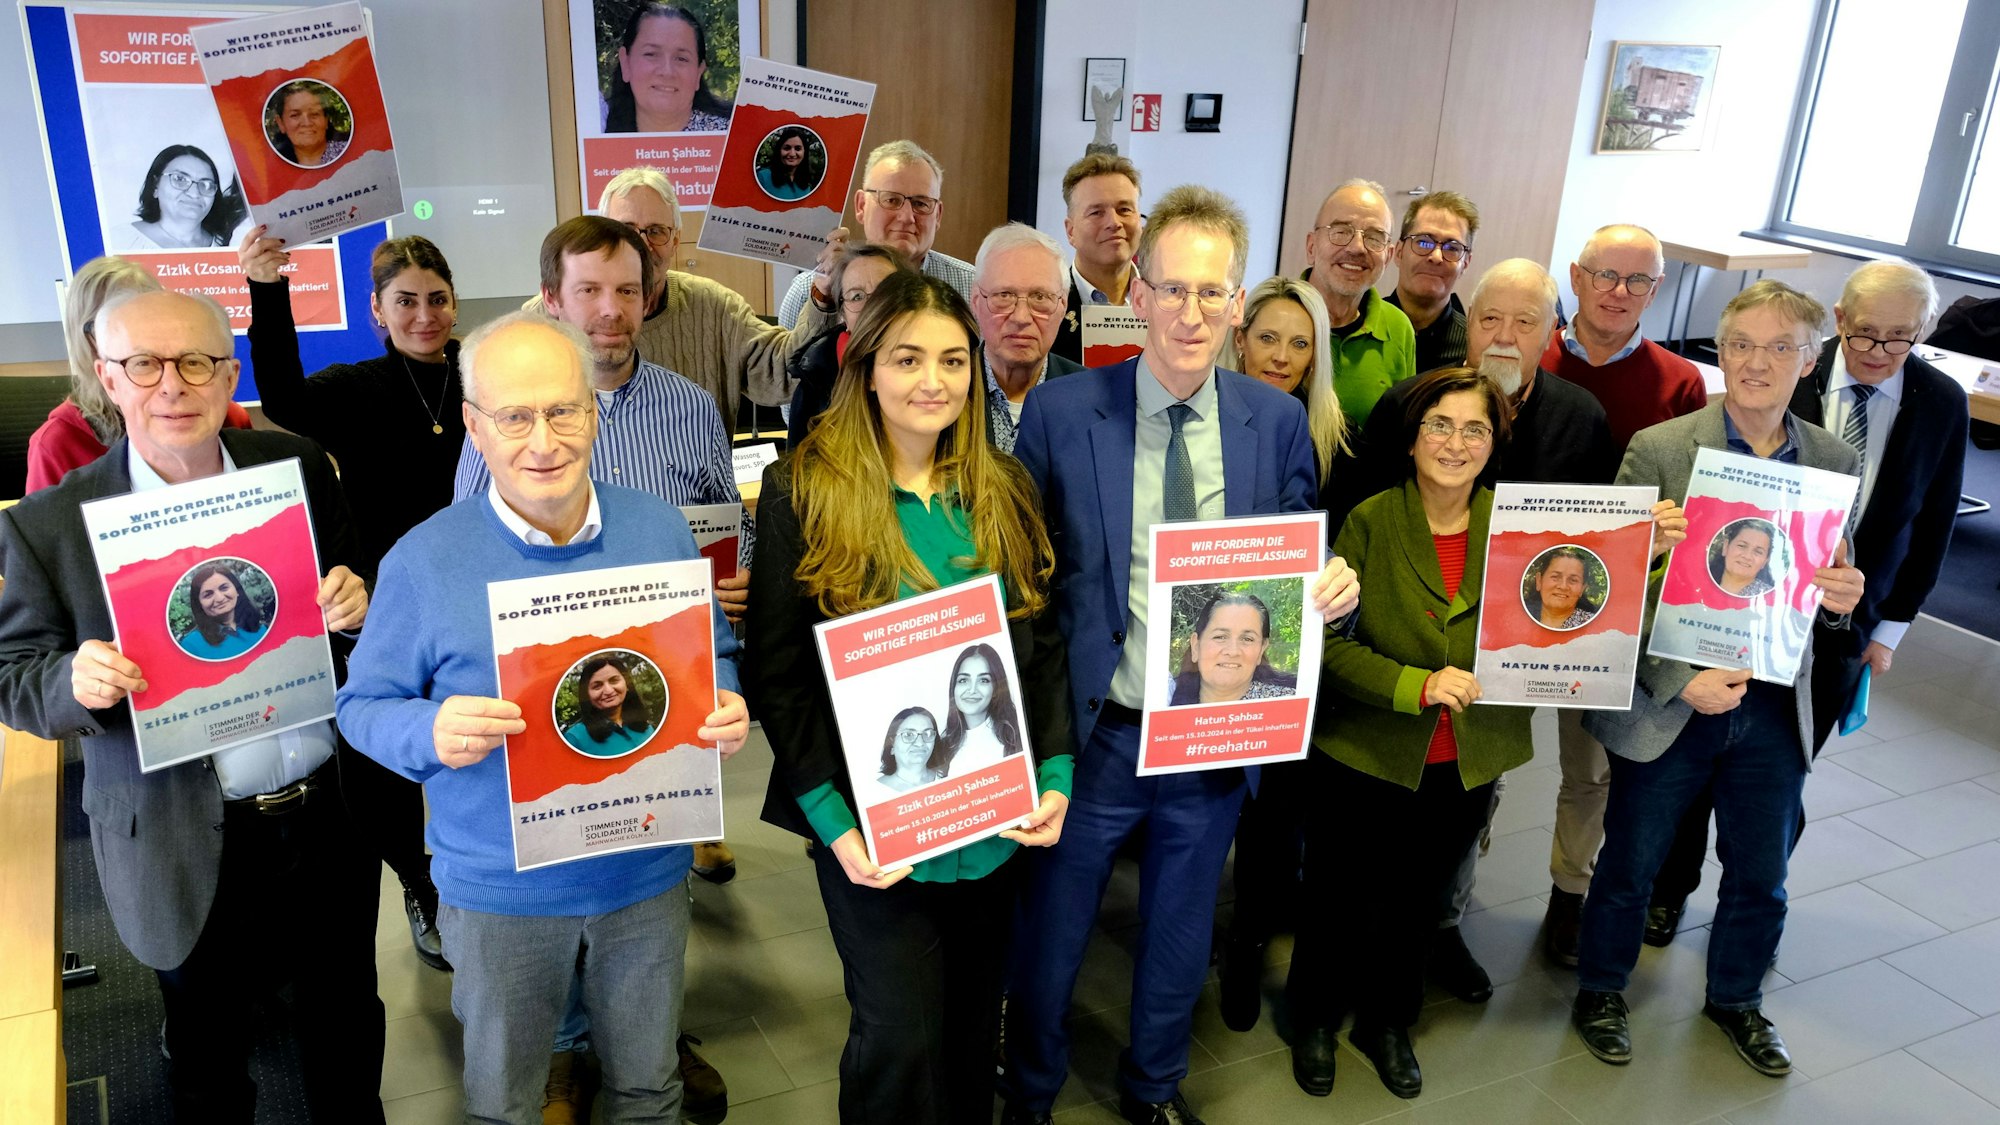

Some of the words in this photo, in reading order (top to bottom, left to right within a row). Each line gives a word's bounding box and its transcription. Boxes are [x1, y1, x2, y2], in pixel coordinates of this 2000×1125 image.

[128, 32, 157, 46] WIR
[161, 33, 192, 46] FOR
[203, 41, 274, 59] SOFORTIGE
[276, 24, 362, 46] FREILASSUNG!
[226, 35, 251, 46] WIR
[254, 25, 311, 41] FORDERN
[314, 21, 334, 31] DIE
[100, 51, 187, 65] SOFORTIGE
[744, 77, 800, 95] SOFORTIGE
[801, 88, 868, 109] FREILASSUNG!
[767, 74, 786, 84] WIR
[788, 79, 832, 94] FORDERN
[834, 89, 850, 97] DIE
[636, 148, 670, 159] Hatun
[673, 147, 711, 161] Şahbaz
[593, 168, 608, 177] Seit
[671, 165, 679, 173] in
[679, 165, 692, 173] der
[693, 164, 714, 173] Tükei
[278, 201, 325, 219] HATUN
[327, 184, 379, 206] ŞAHBAZ
[742, 221, 787, 236] (ZOSAN)
[156, 264, 192, 277] Zizik
[228, 286, 238, 295] in
[239, 286, 250, 296] de
[289, 282, 329, 293] haftiert!
[753, 460, 766, 468] SPD
[1698, 468, 1759, 487] SOFORTIGE
[1722, 466, 1744, 475] WIR
[1746, 470, 1801, 487] FORDERN
[129, 509, 161, 524] WIR
[163, 493, 236, 515] FORDERN
[239, 487, 264, 498] DIE
[1497, 504, 1564, 513] SOFORTIGE
[1566, 506, 1652, 515] FREILASSUNG!
[1523, 497, 1546, 505] WIR
[1548, 498, 1605, 506] FORDERN
[98, 514, 188, 541] SOFORTIGE
[191, 489, 298, 520] FREILASSUNG!
[692, 525, 736, 533] SSUNG!
[1191, 540, 1213, 552] WIR
[1214, 537, 1266, 550] FORDERN
[1266, 535, 1286, 547] DIE
[1169, 553, 1231, 568] SOFORTIGE
[1232, 548, 1308, 564] FREILASSUNG!
[531, 594, 562, 606] WIR
[566, 584, 640, 601] FORDERN
[644, 581, 670, 590] DIE
[498, 601, 588, 621] SOFORTIGE
[593, 588, 706, 608] FREILASSUNG!
[863, 627, 886, 643] WIR
[886, 611, 939, 636] FORDERN
[940, 605, 960, 620] DIE
[1678, 616, 1722, 632] HATUN
[844, 635, 907, 664] SOFORTIGE
[908, 612, 986, 644] FREILASSUNG!
[1501, 662, 1550, 670] HATUN
[1552, 663, 1610, 673] ŞAHBAZ
[193, 691, 261, 717] (ZOSAN)
[263, 671, 327, 697] ŞAHBAZ
[1526, 686, 1567, 694] SOLIDARITÄT
[209, 715, 244, 731] STIMMEN
[245, 711, 260, 720] DER
[210, 717, 260, 738] SOLIDARITÄT
[1194, 715, 1226, 726] Hatun
[1227, 711, 1264, 725] Şahbaz
[1154, 734, 1169, 743] Seit
[1169, 732, 1185, 742] dem
[1185, 729, 1224, 739] 15.10.2024
[1225, 727, 1232, 735] in
[1233, 727, 1244, 735] der
[1246, 724, 1264, 734] Tükei
[1264, 722, 1300, 732] inhaftiert!
[1185, 739, 1267, 757] #freehatun
[570, 795, 641, 816] (ZOSAN)
[644, 787, 714, 804] ŞAHBAZ
[897, 801, 923, 816] Zizik
[924, 785, 964, 807] (Zosan)
[964, 773, 1001, 794] Şahbaz
[879, 829, 895, 840] Seit
[895, 823, 911, 834] dem
[911, 809, 950, 830] 15.10.2024
[950, 806, 958, 814] in
[957, 802, 970, 813] der
[971, 797, 989, 808] Tükei
[989, 783, 1025, 802] inhaftiert!
[585, 820, 622, 833] STIMMEN
[623, 817, 639, 827] DER
[585, 824, 638, 841] SOLIDARITÄT
[915, 808, 997, 846] #freezosan
[585, 836, 625, 848] MAHNWACHE
[626, 832, 643, 841] KÖLN
